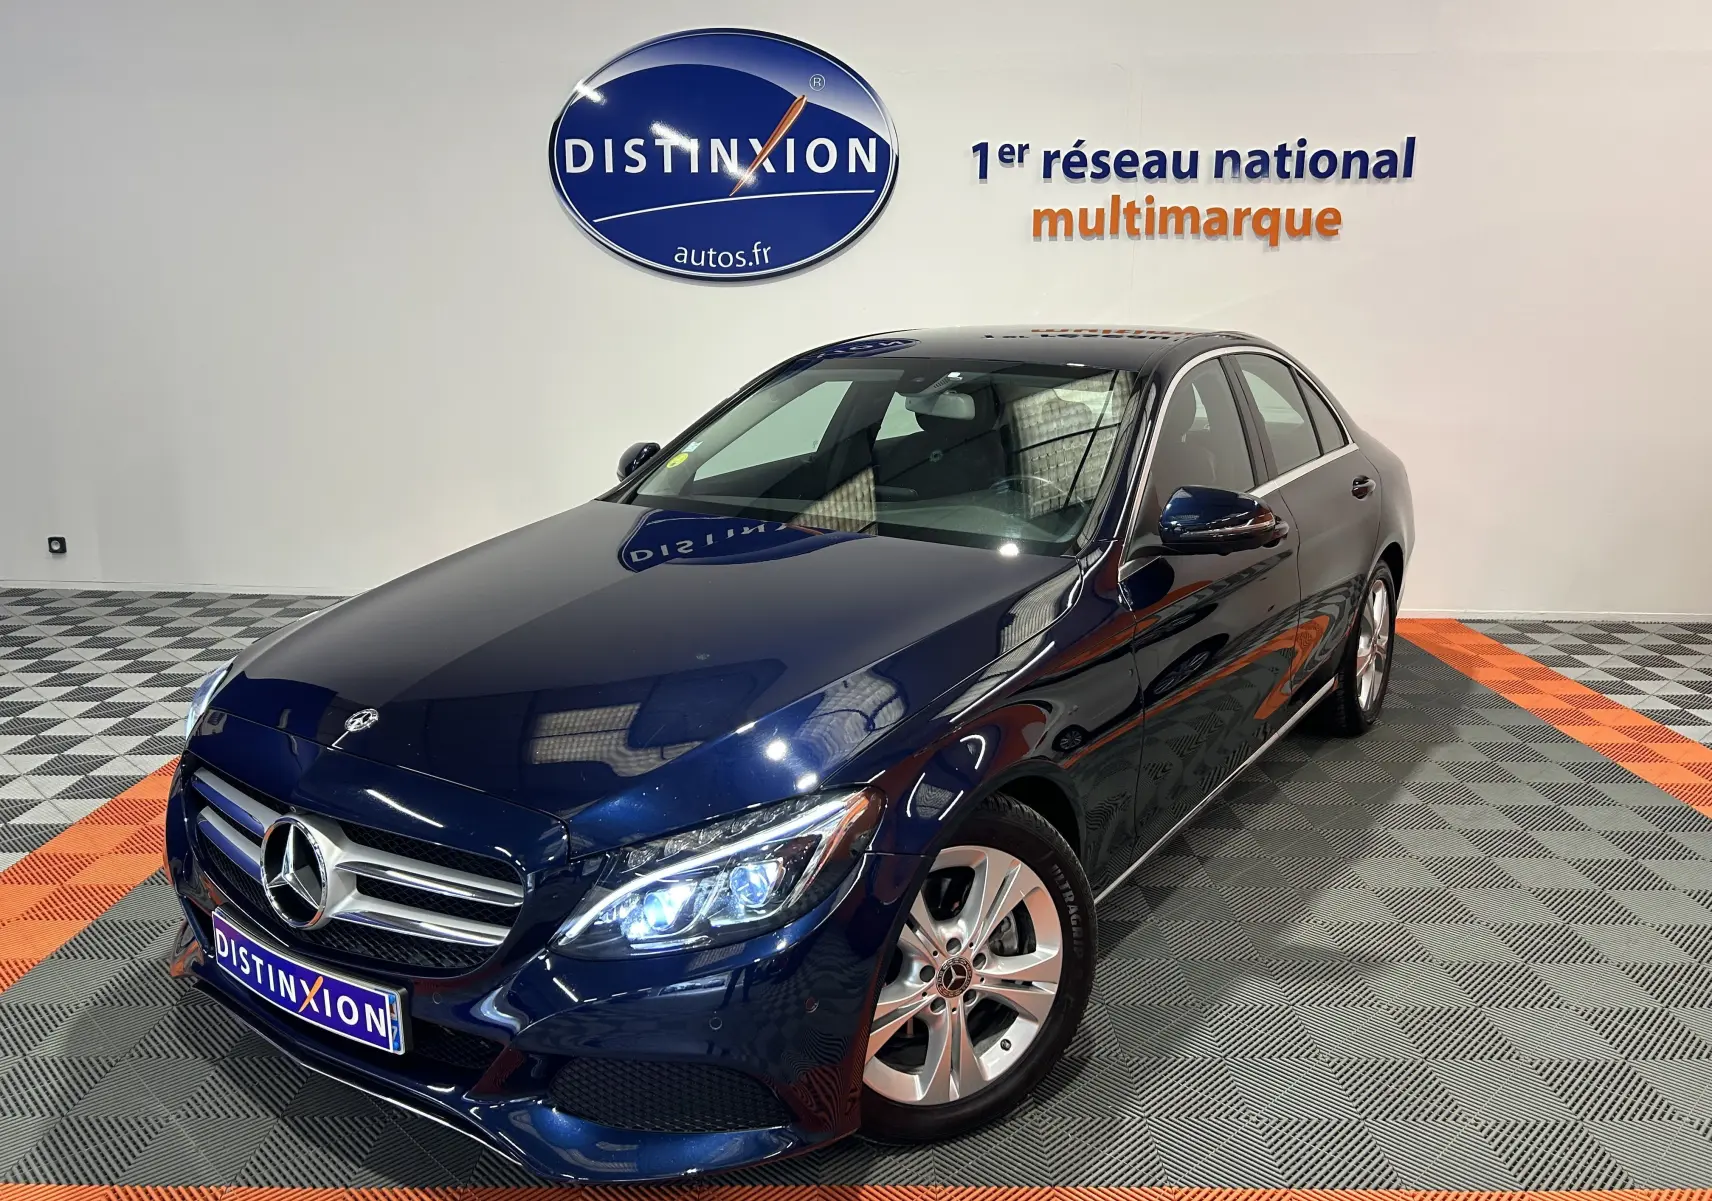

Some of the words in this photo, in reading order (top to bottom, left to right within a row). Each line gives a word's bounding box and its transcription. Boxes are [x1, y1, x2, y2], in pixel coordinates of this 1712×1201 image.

[564, 137, 878, 174] DISTINXION
[971, 141, 1030, 180] 1er
[1042, 139, 1199, 179] réseau
[1213, 136, 1416, 179] national
[1032, 195, 1342, 247] multimarque
[673, 241, 772, 268] autos.fr
[215, 928, 387, 1038] DISTINXION
